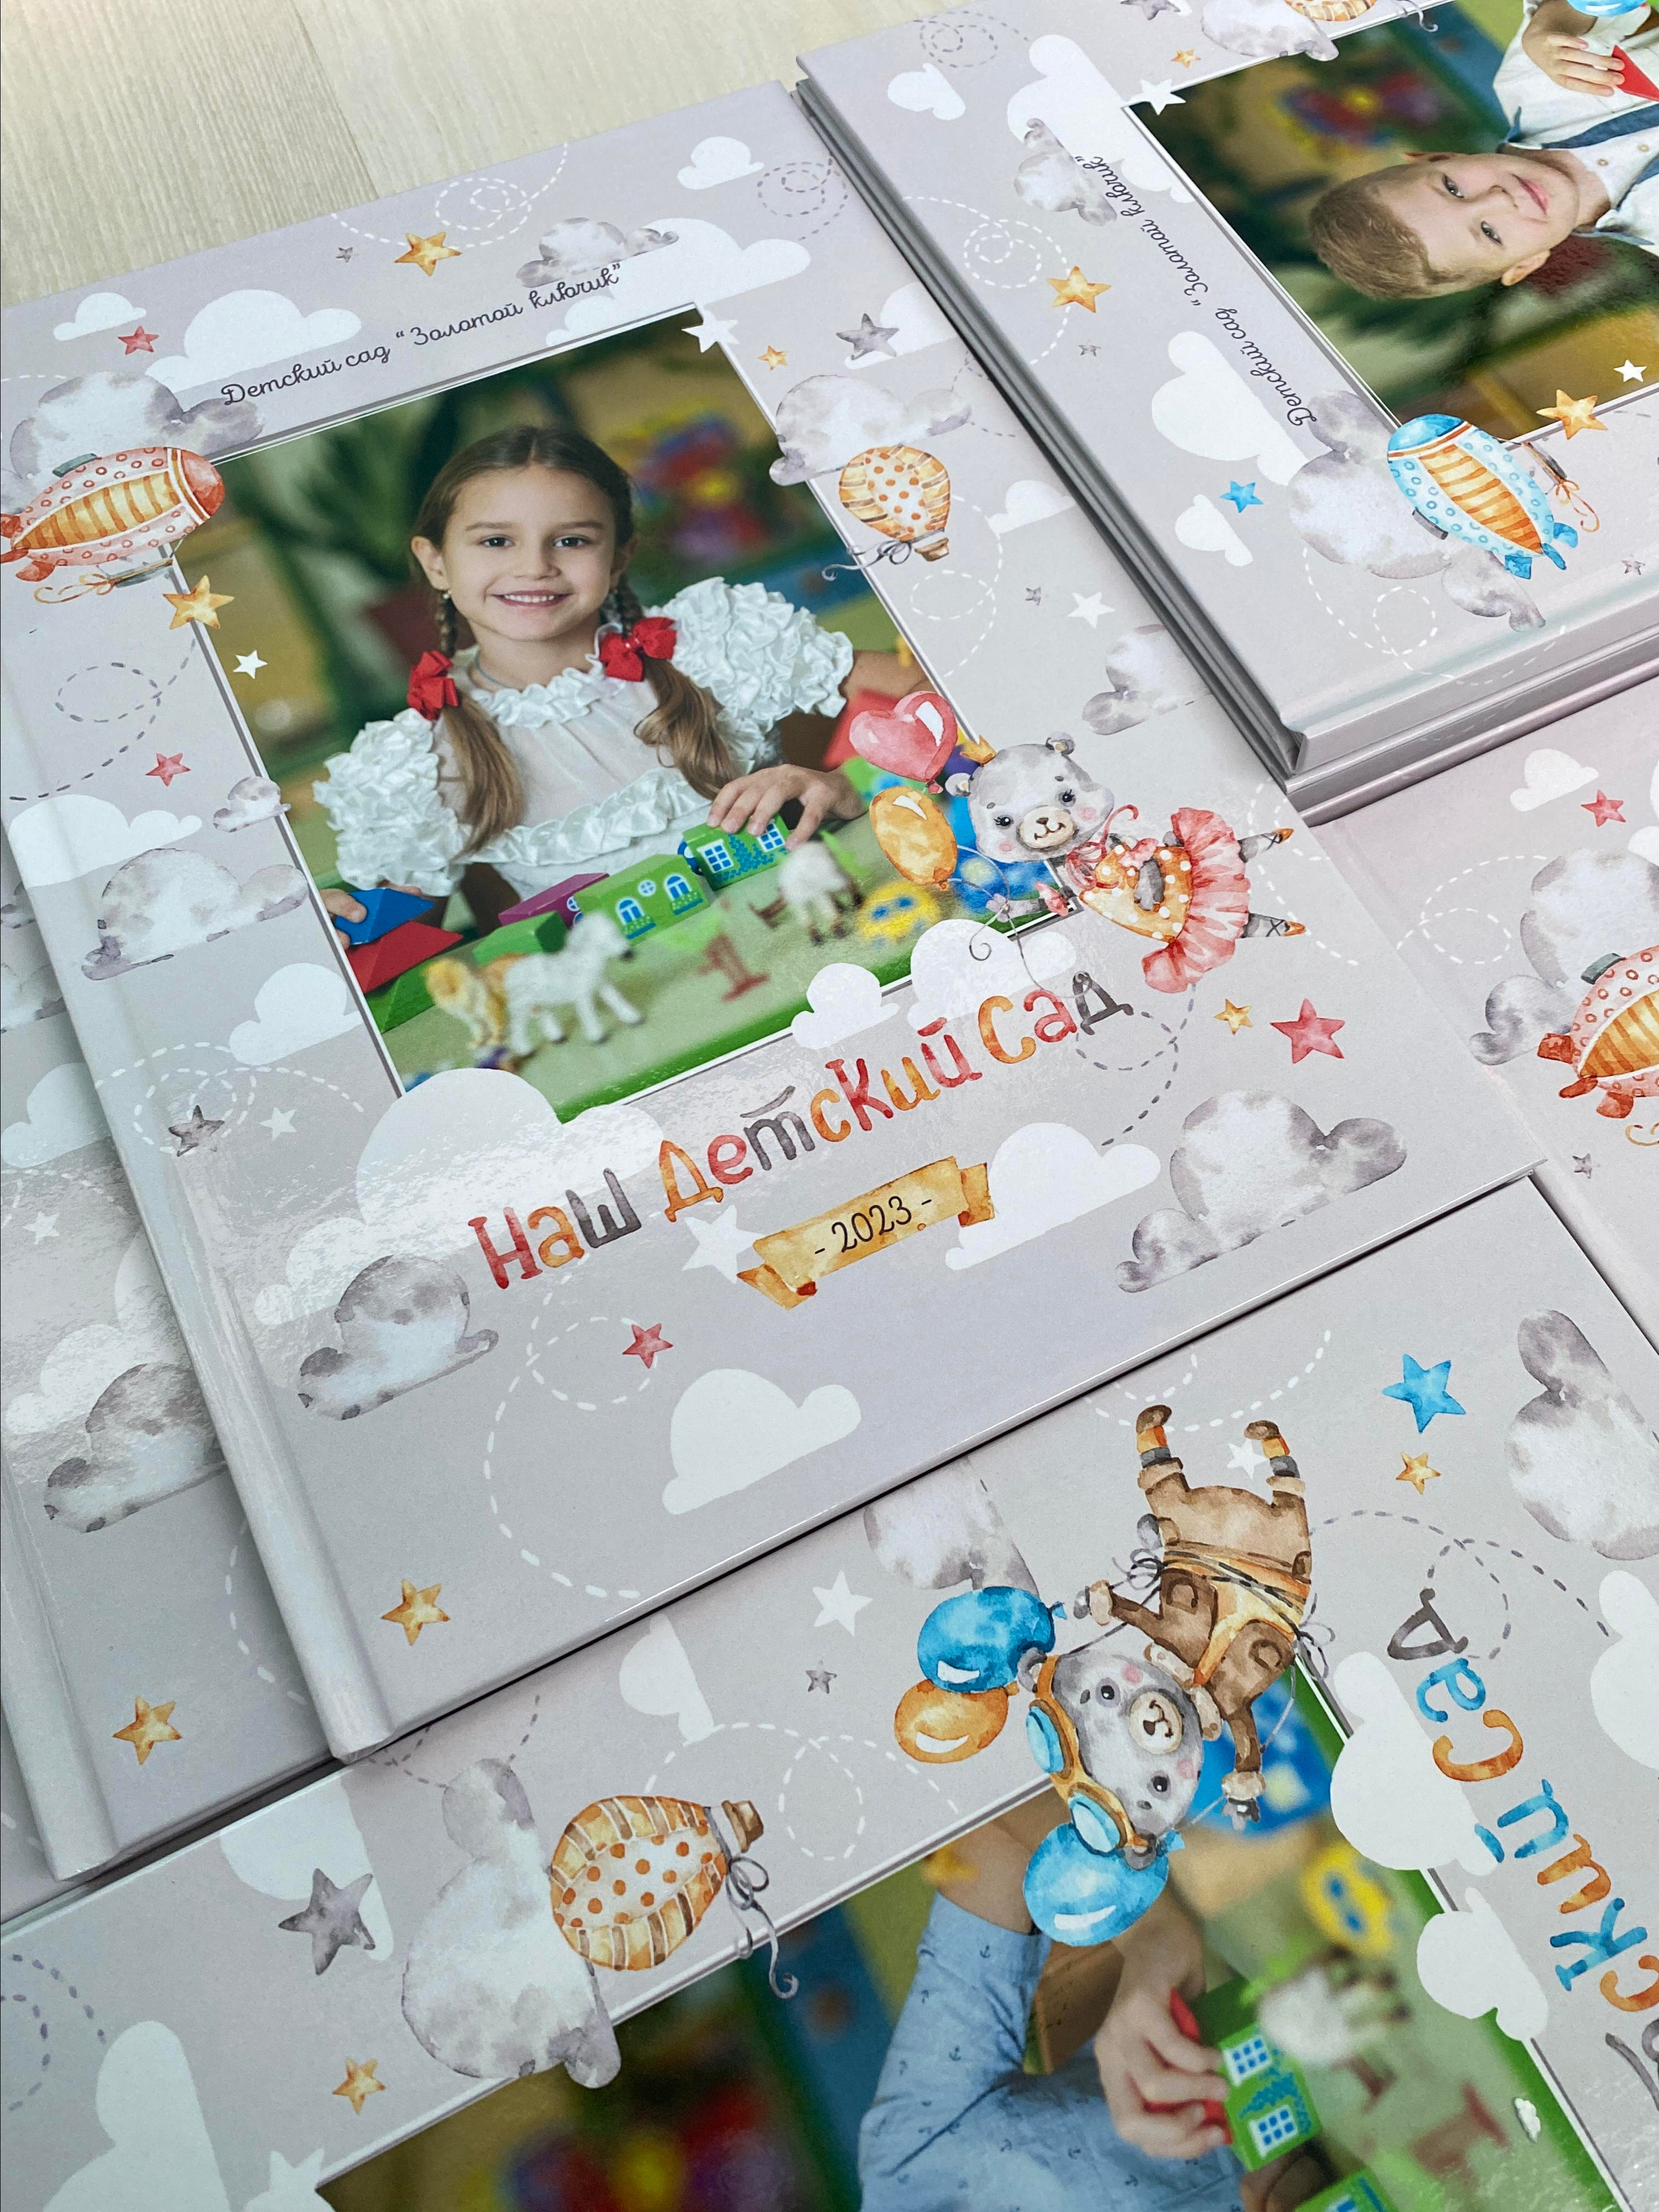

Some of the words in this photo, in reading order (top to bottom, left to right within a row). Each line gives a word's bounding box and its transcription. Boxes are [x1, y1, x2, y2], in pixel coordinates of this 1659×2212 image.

[1215, 308, 1246, 339] сад
[221, 360, 342, 406] Детский
[345, 345, 391, 367] сад
[1240, 341, 1317, 426] Детский
[977, 971, 1134, 1065] Сад
[831, 1195, 912, 1253] 2023
[1387, 1588, 1524, 1783] Сад
